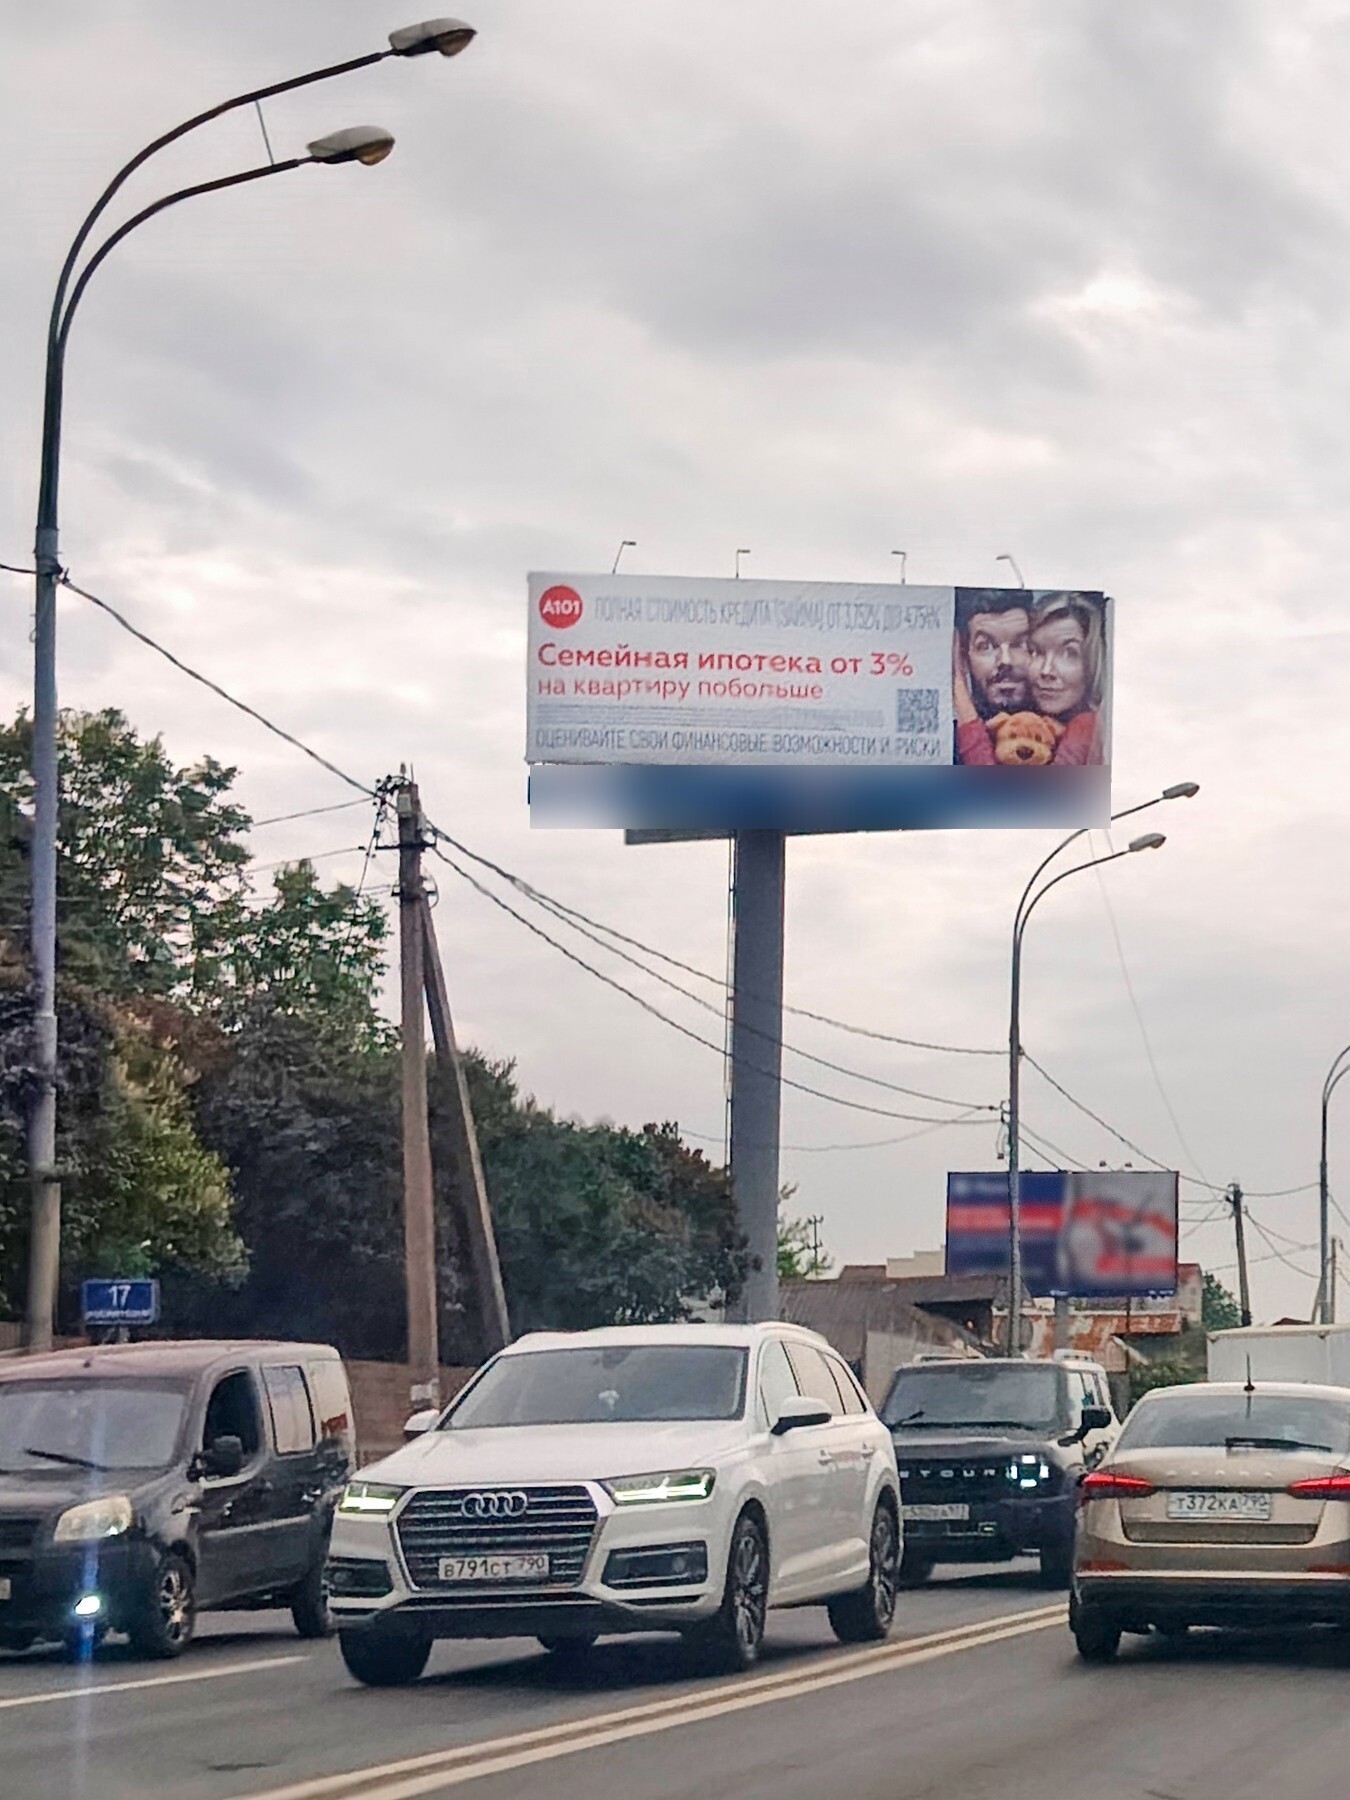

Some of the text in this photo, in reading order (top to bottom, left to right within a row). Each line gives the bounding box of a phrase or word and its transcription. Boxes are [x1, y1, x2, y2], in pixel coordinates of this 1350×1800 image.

[596, 596, 643, 623] ПОЛНАЯ
[645, 597, 718, 624] СТОИМОСТЬ
[720, 599, 772, 628] КРЕДИТА
[537, 642, 914, 677] Семейная ипотека от 3%
[537, 677, 824, 701] на квартиру побольше
[535, 727, 626, 750] ОЦЕНИВАЙТЕ
[629, 729, 669, 750] СВОИ
[671, 731, 768, 754] ФИНАНСОВЫЕ
[773, 733, 877, 756] ВОЗМОЖНОСТИ
[894, 738, 941, 758] РИСКИ
[108, 1285, 131, 1306] 17
[899, 1469, 996, 1478] ETOUR
[444, 1559, 512, 1578] В791СТ
